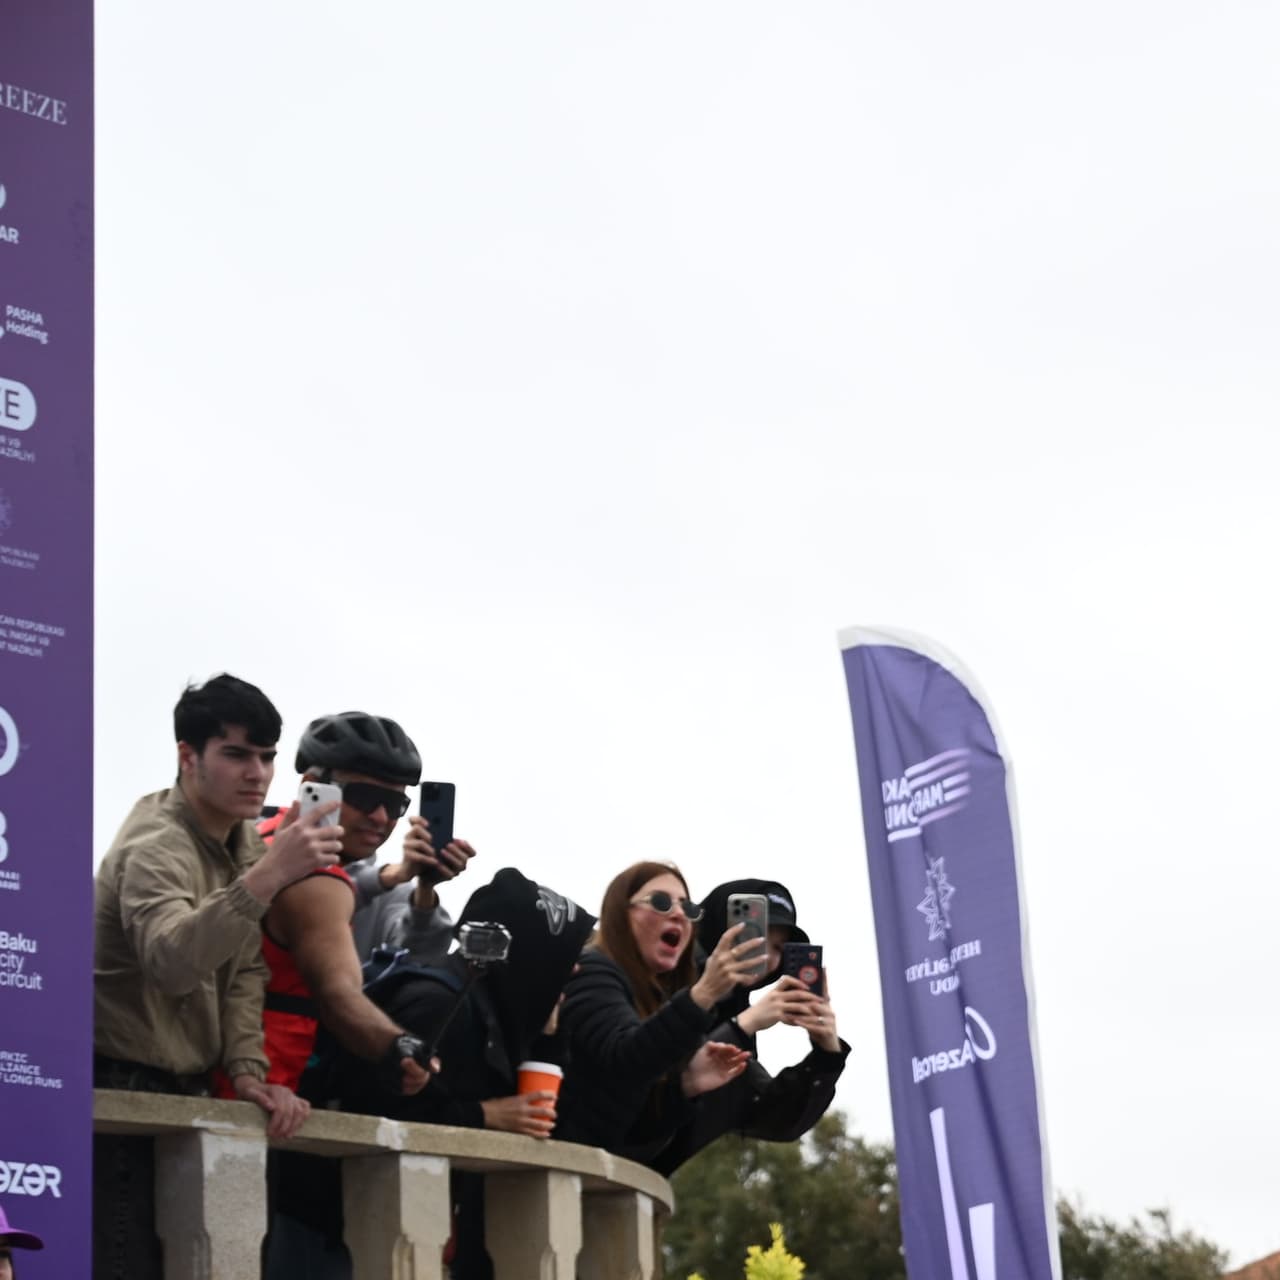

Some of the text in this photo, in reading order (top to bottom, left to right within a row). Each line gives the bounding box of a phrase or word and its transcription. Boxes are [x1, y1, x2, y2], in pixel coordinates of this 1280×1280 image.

[0, 82, 68, 126] EEZE
[6, 305, 44, 325] PASHA
[6, 320, 48, 344] Holding
[0, 931, 37, 953] Baku
[0, 951, 25, 974] city
[0, 968, 43, 990] circuit
[4, 1072, 63, 1089] LONG RUNS
